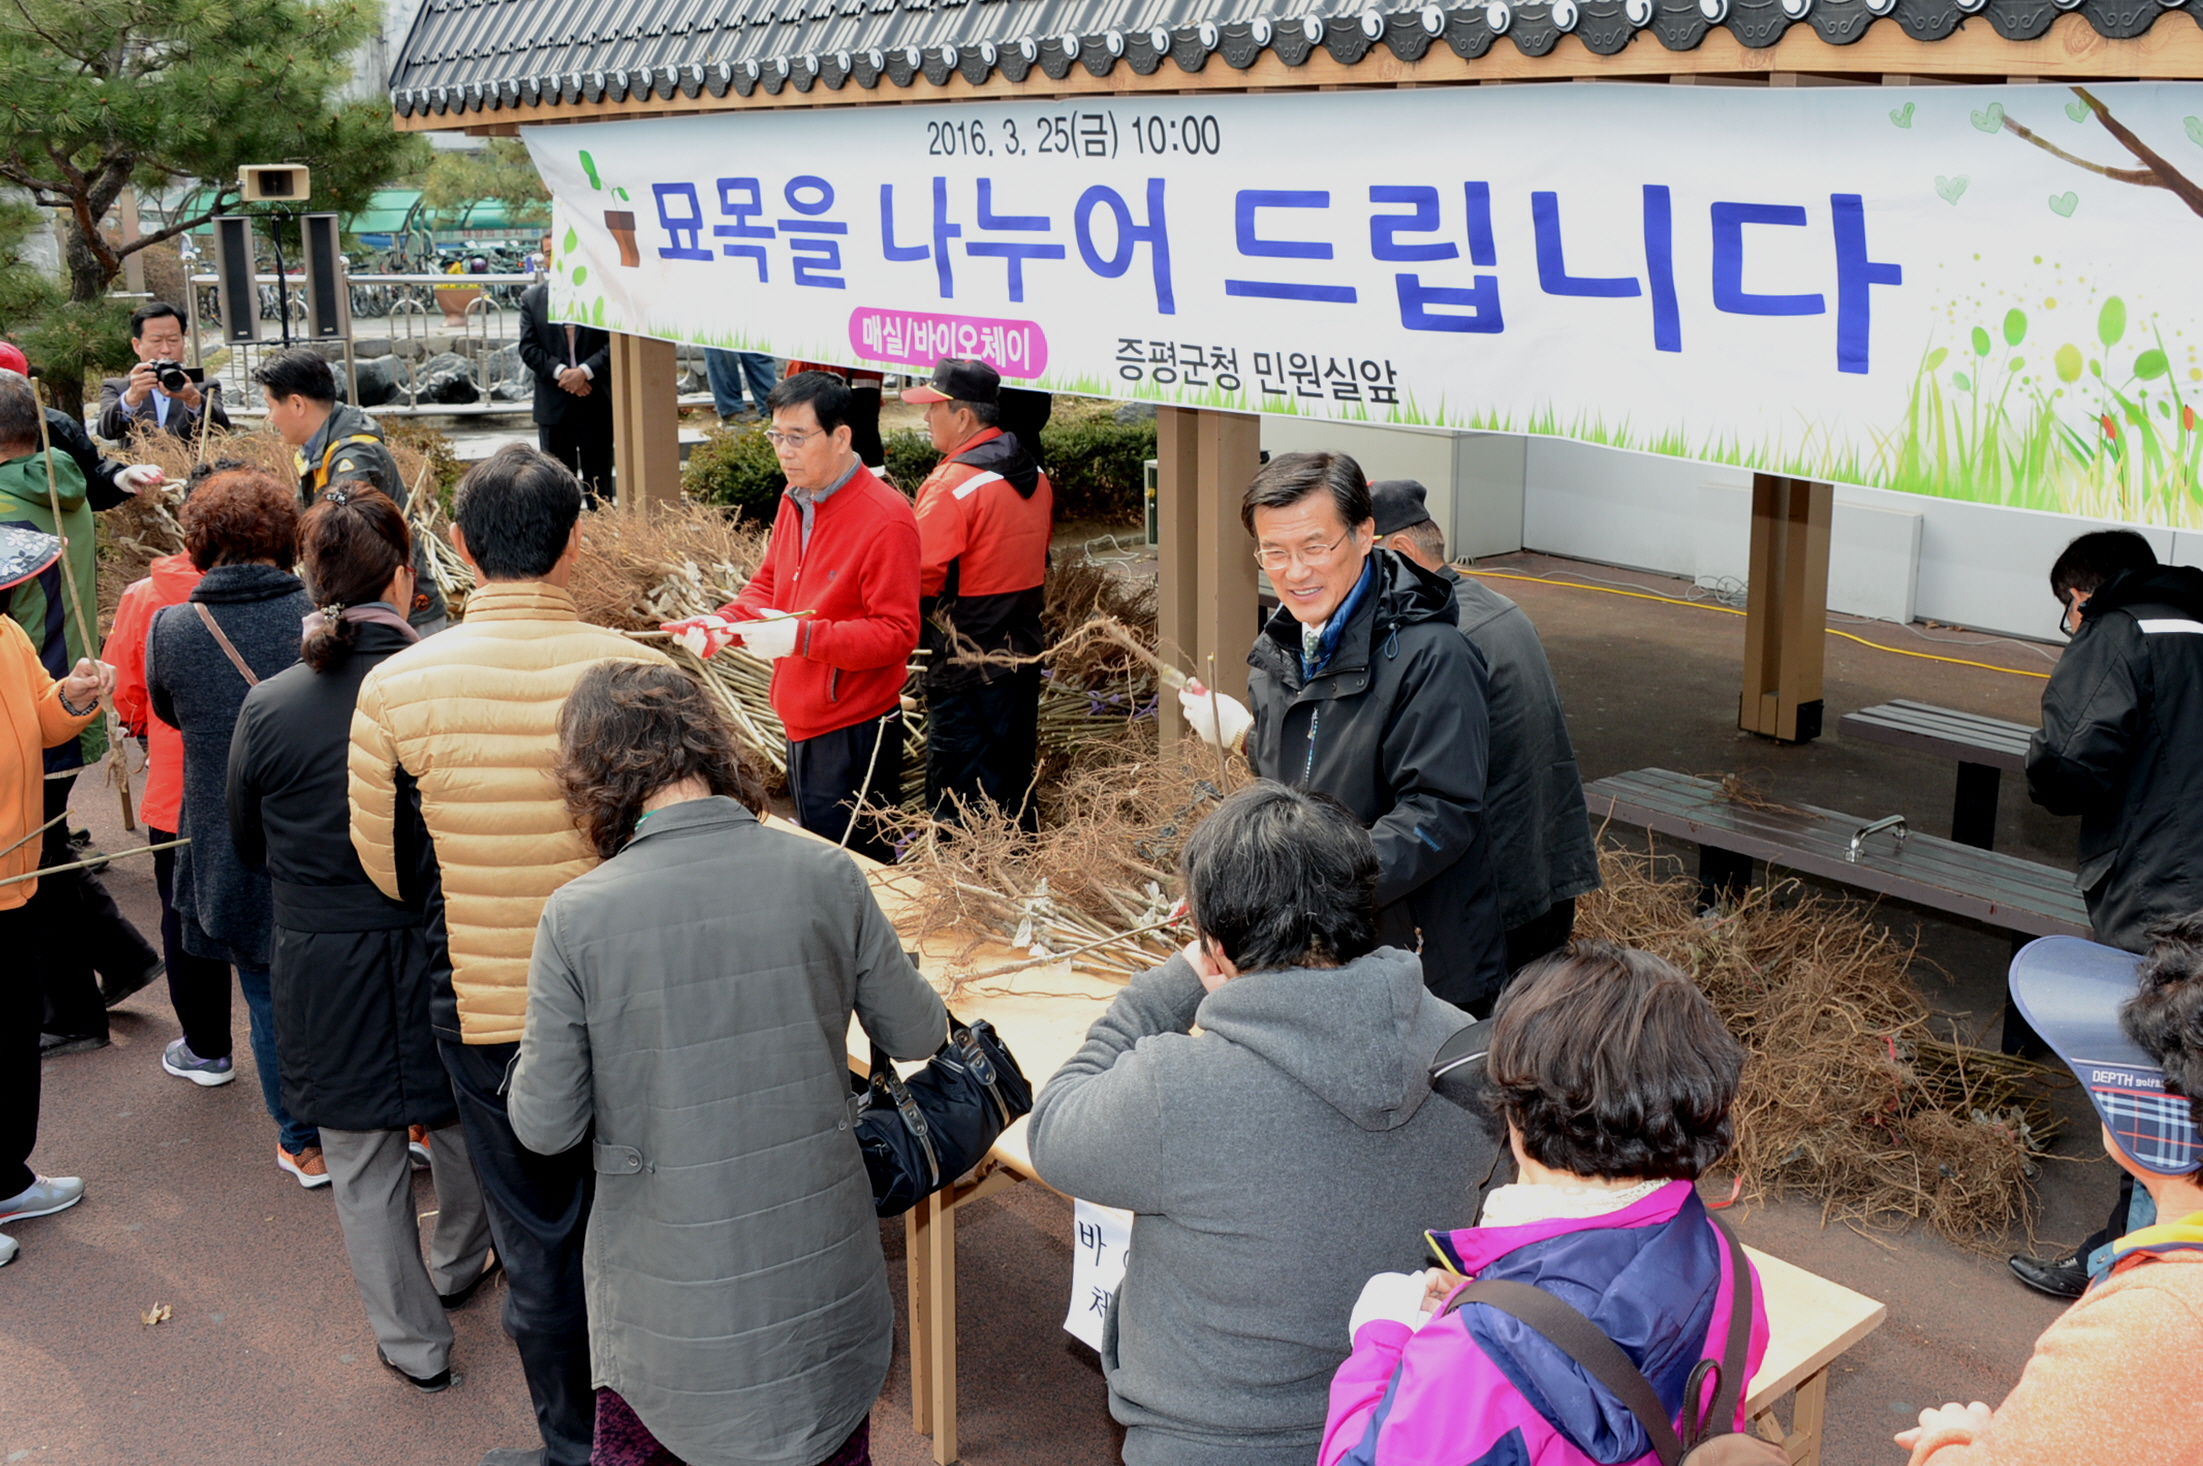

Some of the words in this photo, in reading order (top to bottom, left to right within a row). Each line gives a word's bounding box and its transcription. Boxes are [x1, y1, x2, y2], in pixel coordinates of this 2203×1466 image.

[927, 119, 993, 156] 2016.
[1002, 118, 1026, 156] 3.
[1037, 110, 1118, 159] 25(금)
[1132, 114, 1220, 155] 10:00
[652, 175, 847, 289] 묘목을
[881, 176, 1175, 315] 나누어
[1225, 181, 1902, 375] 드립니다
[862, 315, 1030, 371] 매실/바이오체이
[1116, 338, 1240, 391] 증평군청
[1253, 352, 1400, 404] 민원실앞
[2092, 1070, 2134, 1087] DEPTH
